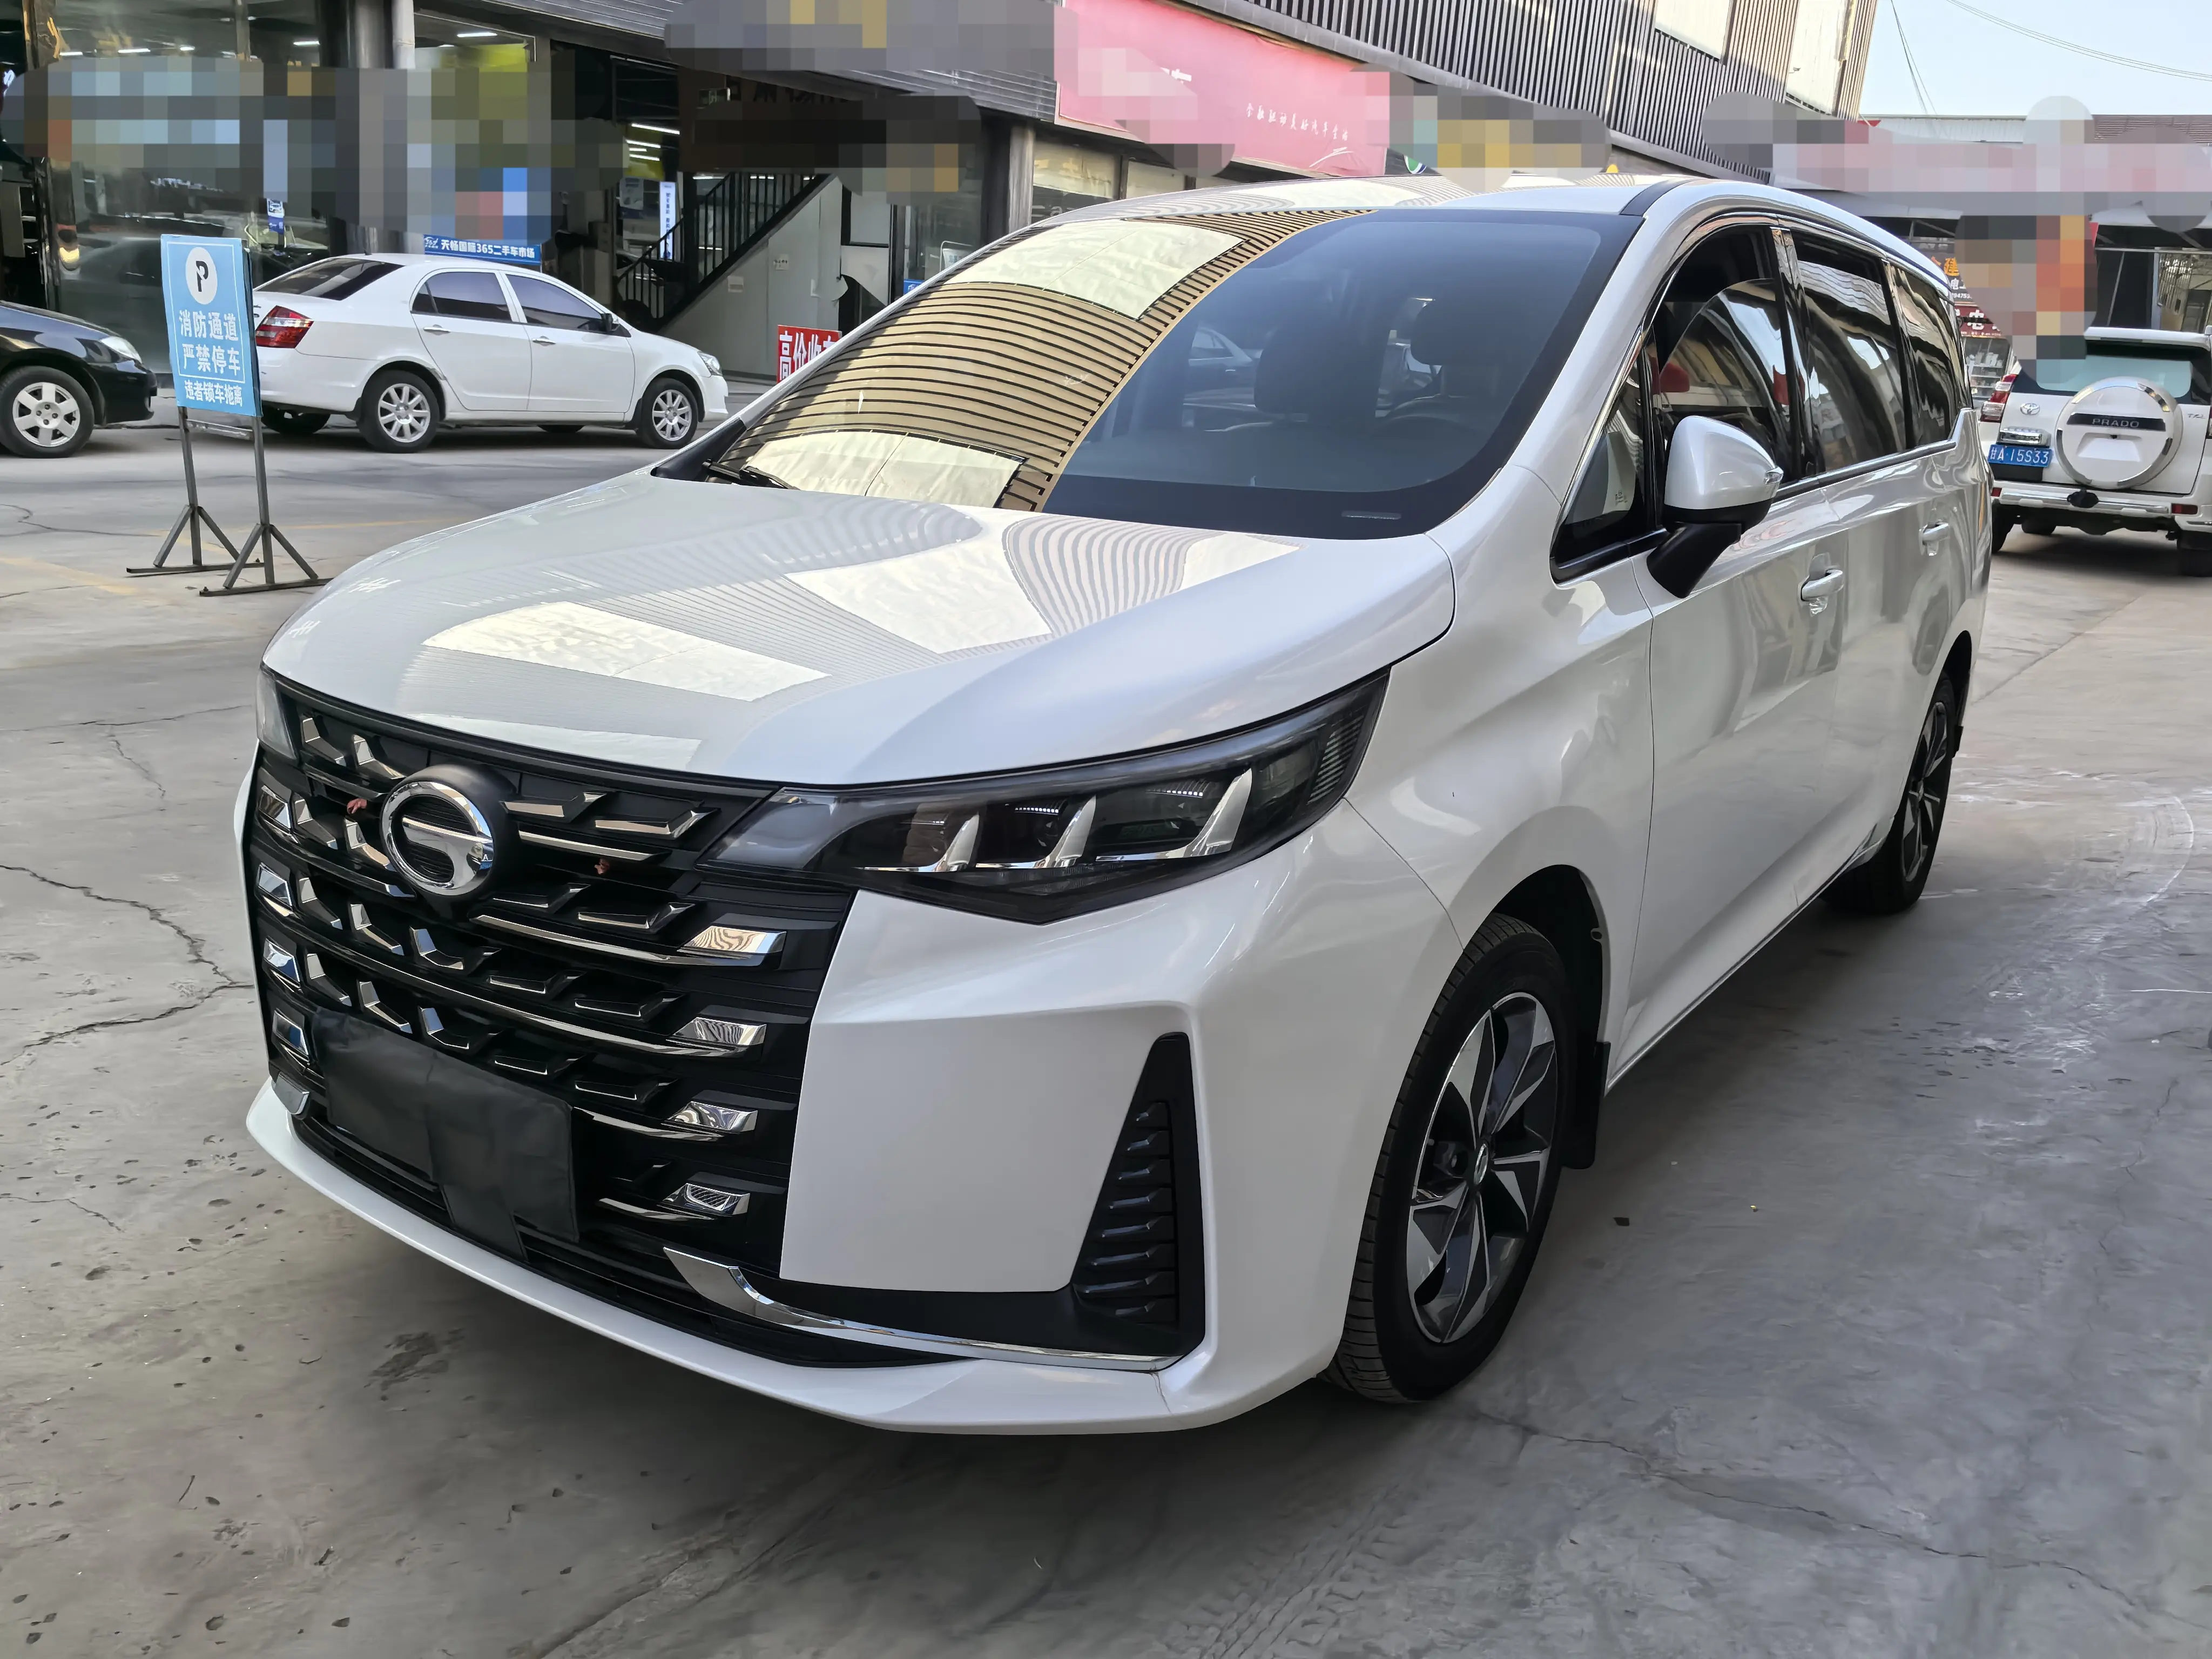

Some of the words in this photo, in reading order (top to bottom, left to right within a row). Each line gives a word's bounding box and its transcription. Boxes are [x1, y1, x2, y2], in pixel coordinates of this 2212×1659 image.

[179, 309, 239, 341] 消防通道
[182, 343, 240, 375] 严禁停车
[184, 379, 242, 407] 违者锁车拖离
[2092, 418, 2140, 428] PRADO
